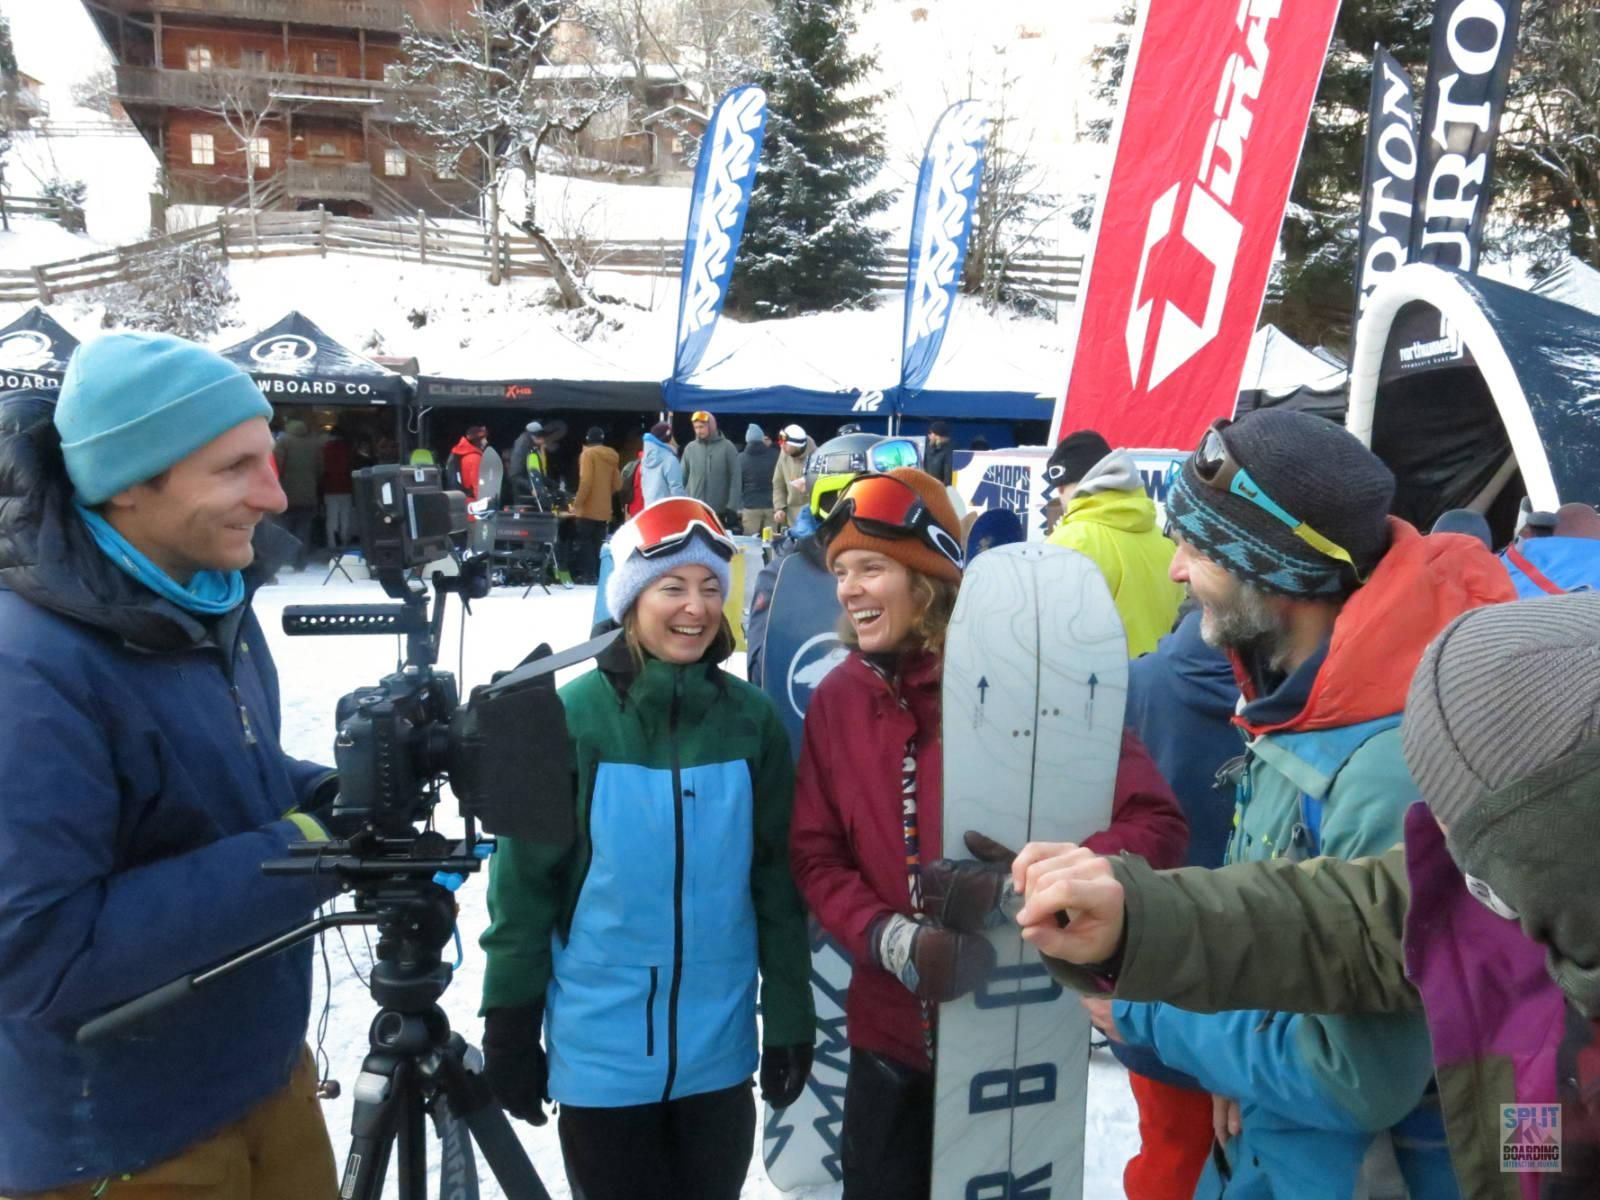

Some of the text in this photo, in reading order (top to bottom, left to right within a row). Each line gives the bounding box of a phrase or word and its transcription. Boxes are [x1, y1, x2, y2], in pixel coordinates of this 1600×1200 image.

[1359, 62, 1417, 306] RTON
[345, 383, 377, 395] CO.
[851, 390, 884, 411] K2
[983, 465, 1031, 491] SHOPS
